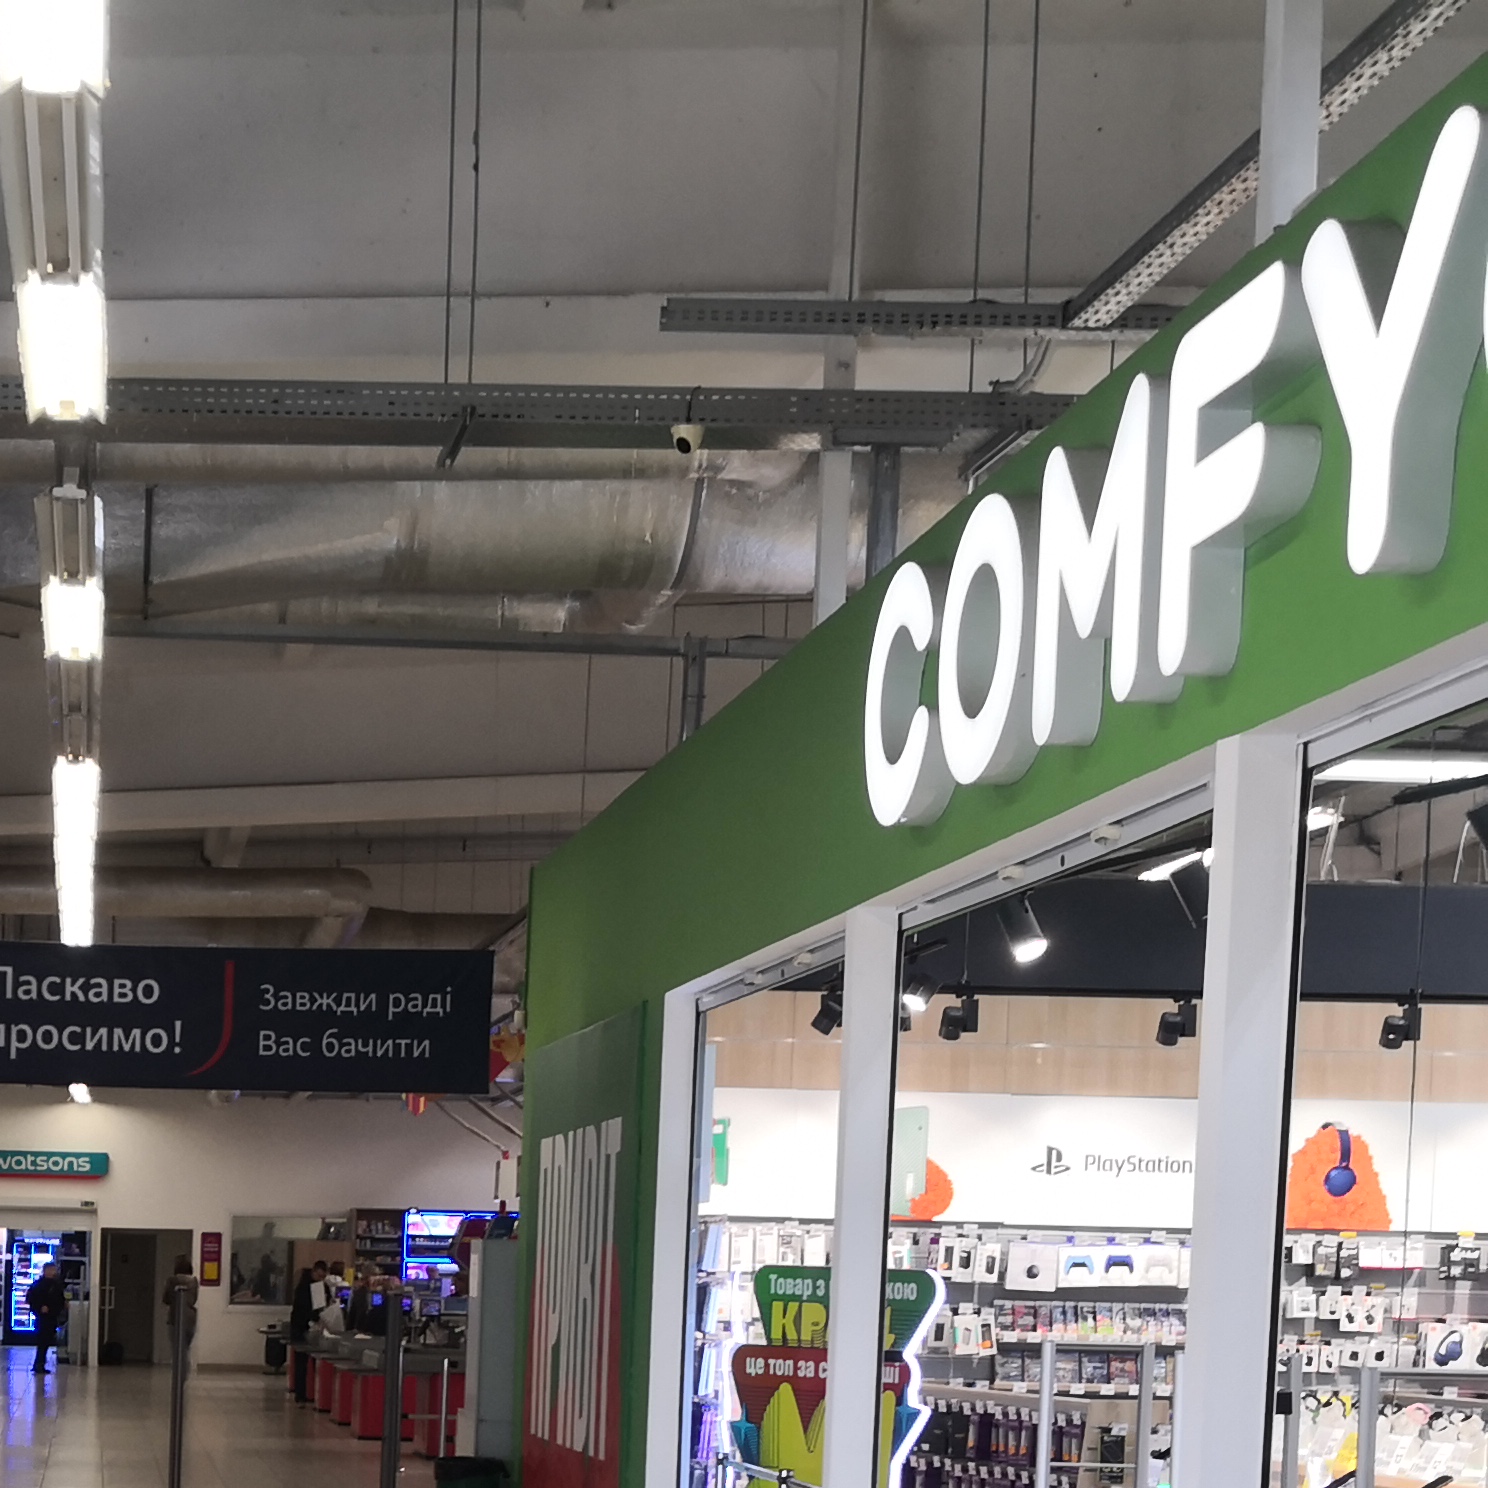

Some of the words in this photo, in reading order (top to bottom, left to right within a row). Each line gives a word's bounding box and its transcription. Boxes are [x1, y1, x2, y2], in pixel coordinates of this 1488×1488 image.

[864, 104, 1488, 828] COMFY
[258, 983, 378, 1016] Завжди
[387, 986, 452, 1021] раді
[258, 1030, 311, 1057] Вас
[320, 1028, 431, 1058] бачити
[1084, 1154, 1193, 1178] PlayStation
[768, 1273, 813, 1301] Товар
[745, 1357, 765, 1377] це
[768, 1358, 794, 1376] топ
[797, 1360, 815, 1378] за
